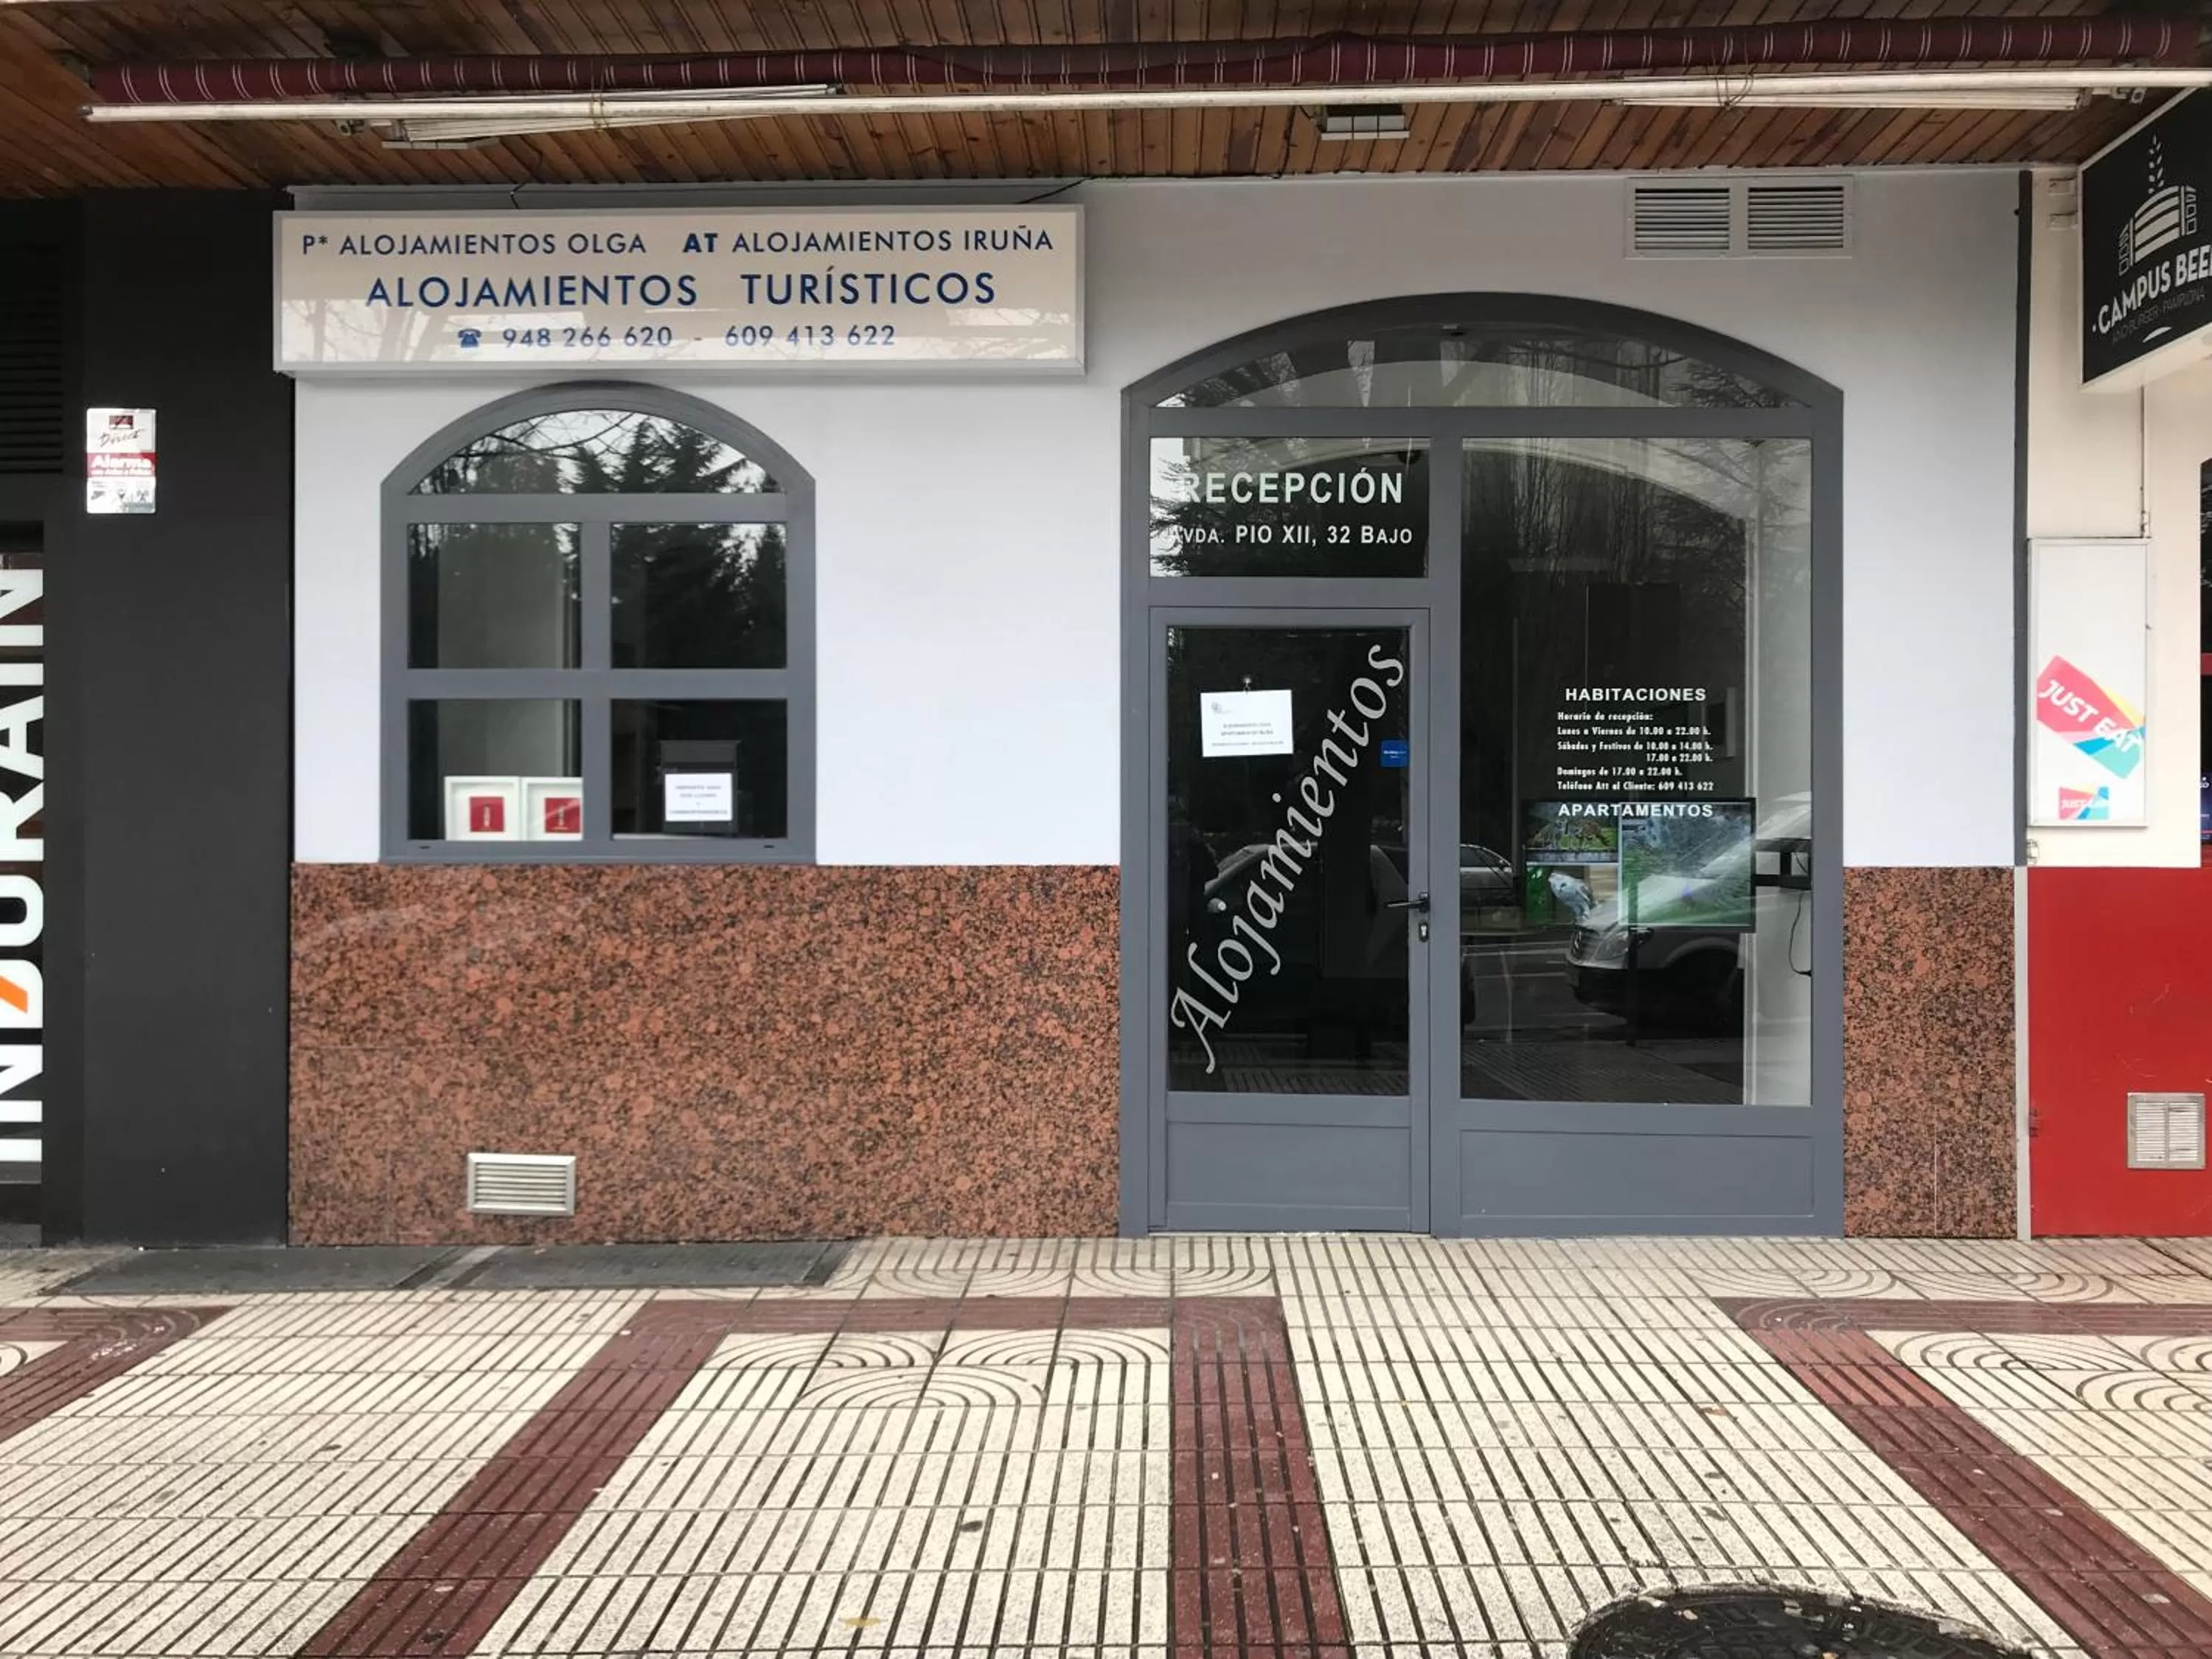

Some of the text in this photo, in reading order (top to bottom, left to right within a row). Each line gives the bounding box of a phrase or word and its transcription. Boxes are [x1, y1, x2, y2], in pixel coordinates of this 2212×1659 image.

[339, 234, 556, 256] ALOJAMIENTOS
[567, 233, 647, 254] OLGA
[682, 224, 1054, 254] AT ALOJAMIENTOS IRUÑA
[366, 266, 996, 308] ALOJAMIENTOS TURÍSTICOS
[2098, 260, 2171, 334] CAMPUS
[502, 328, 551, 347] 948
[563, 328, 611, 347] 266
[624, 326, 672, 347] 620
[725, 326, 773, 347] 609
[787, 326, 835, 347] 413
[847, 325, 896, 347] 622
[1180, 467, 1402, 504] RECEPCIÓN
[1236, 524, 1272, 543] PIO
[1282, 524, 1317, 547] XII,
[1327, 524, 1351, 543] 32
[1565, 688, 1707, 701] HABITACIONES
[2037, 678, 2099, 724] JUST
[1594, 710, 1605, 720] de
[1557, 726, 1581, 735] Lunes
[1592, 726, 1624, 735] Viernes
[1626, 726, 1636, 735] de
[1639, 726, 1664, 735] 10.00
[1674, 726, 1700, 735] 22.00
[1633, 741, 1644, 750] de
[1646, 741, 1669, 751] 10.00
[1646, 753, 1669, 762] 17.00
[1679, 753, 1703, 762] 22.00
[1599, 766, 1609, 776] de
[1612, 766, 1636, 776] 17.00
[1646, 766, 1672, 776] 22.00
[1658, 782, 1674, 790] 609
[1677, 782, 1694, 790] 413
[1696, 782, 1714, 791] 622
[1557, 803, 1714, 817] APARTAMENTOS
[1170, 644, 1405, 1074] Alojamientos
